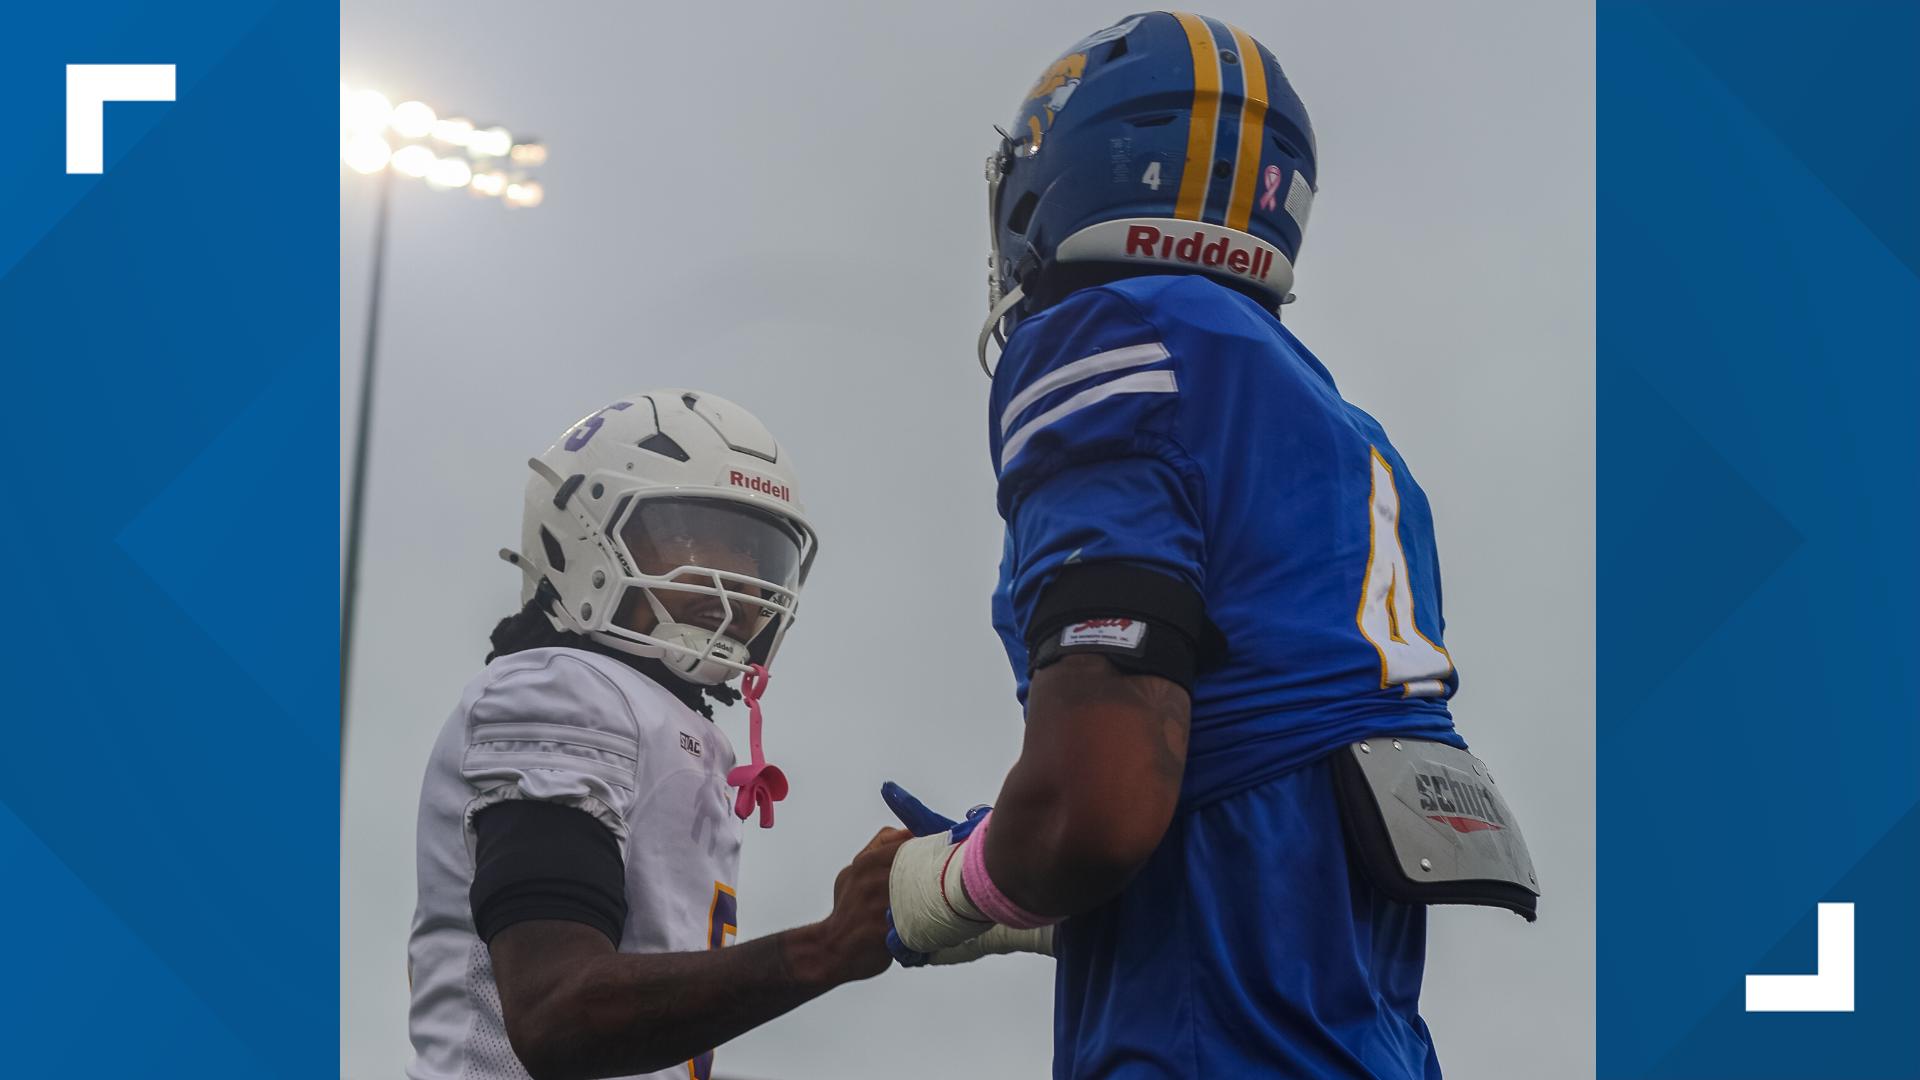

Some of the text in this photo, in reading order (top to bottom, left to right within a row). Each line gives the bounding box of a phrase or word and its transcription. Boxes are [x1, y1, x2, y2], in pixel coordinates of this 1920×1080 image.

[1142, 161, 1161, 191] 4
[1125, 225, 1273, 279] Riddell
[730, 470, 789, 502] Riddell
[1356, 443, 1454, 698] 4
